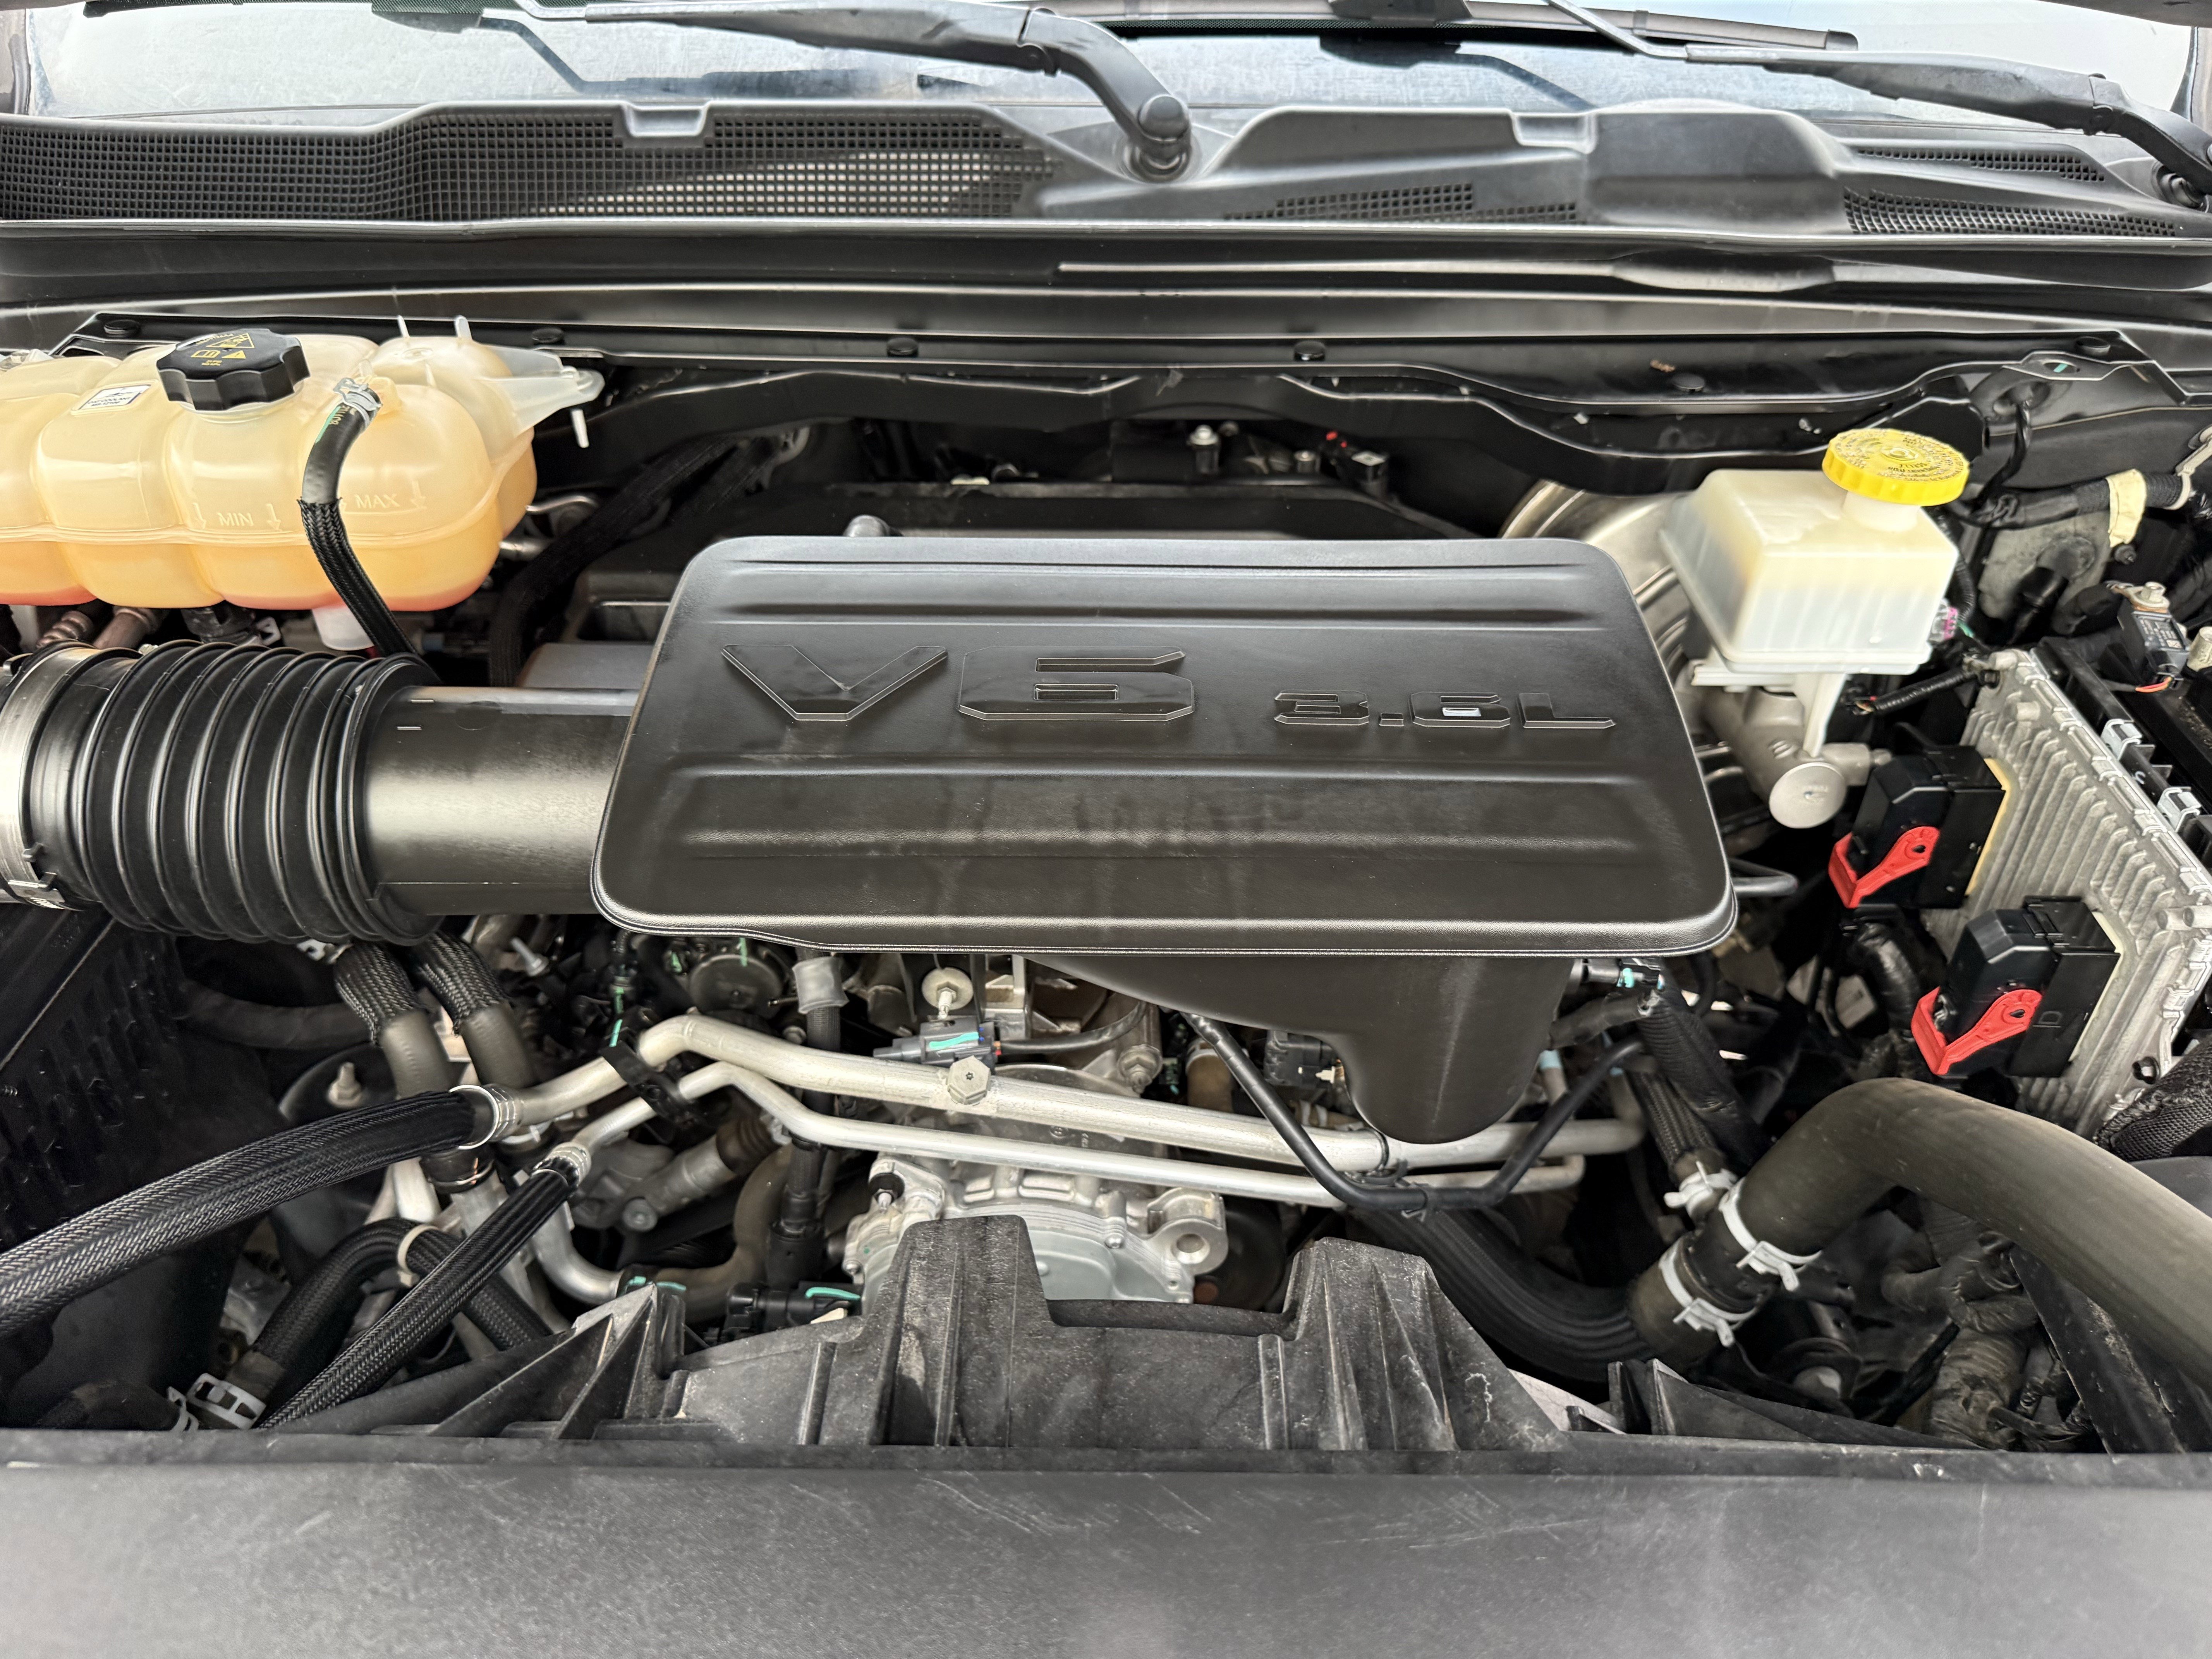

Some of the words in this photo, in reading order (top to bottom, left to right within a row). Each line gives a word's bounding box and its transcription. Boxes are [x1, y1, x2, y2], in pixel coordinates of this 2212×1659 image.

[354, 493, 400, 509] MAX
[217, 512, 254, 526] MIN
[722, 644, 1194, 721] V6
[1274, 690, 1616, 729] 3.6L
